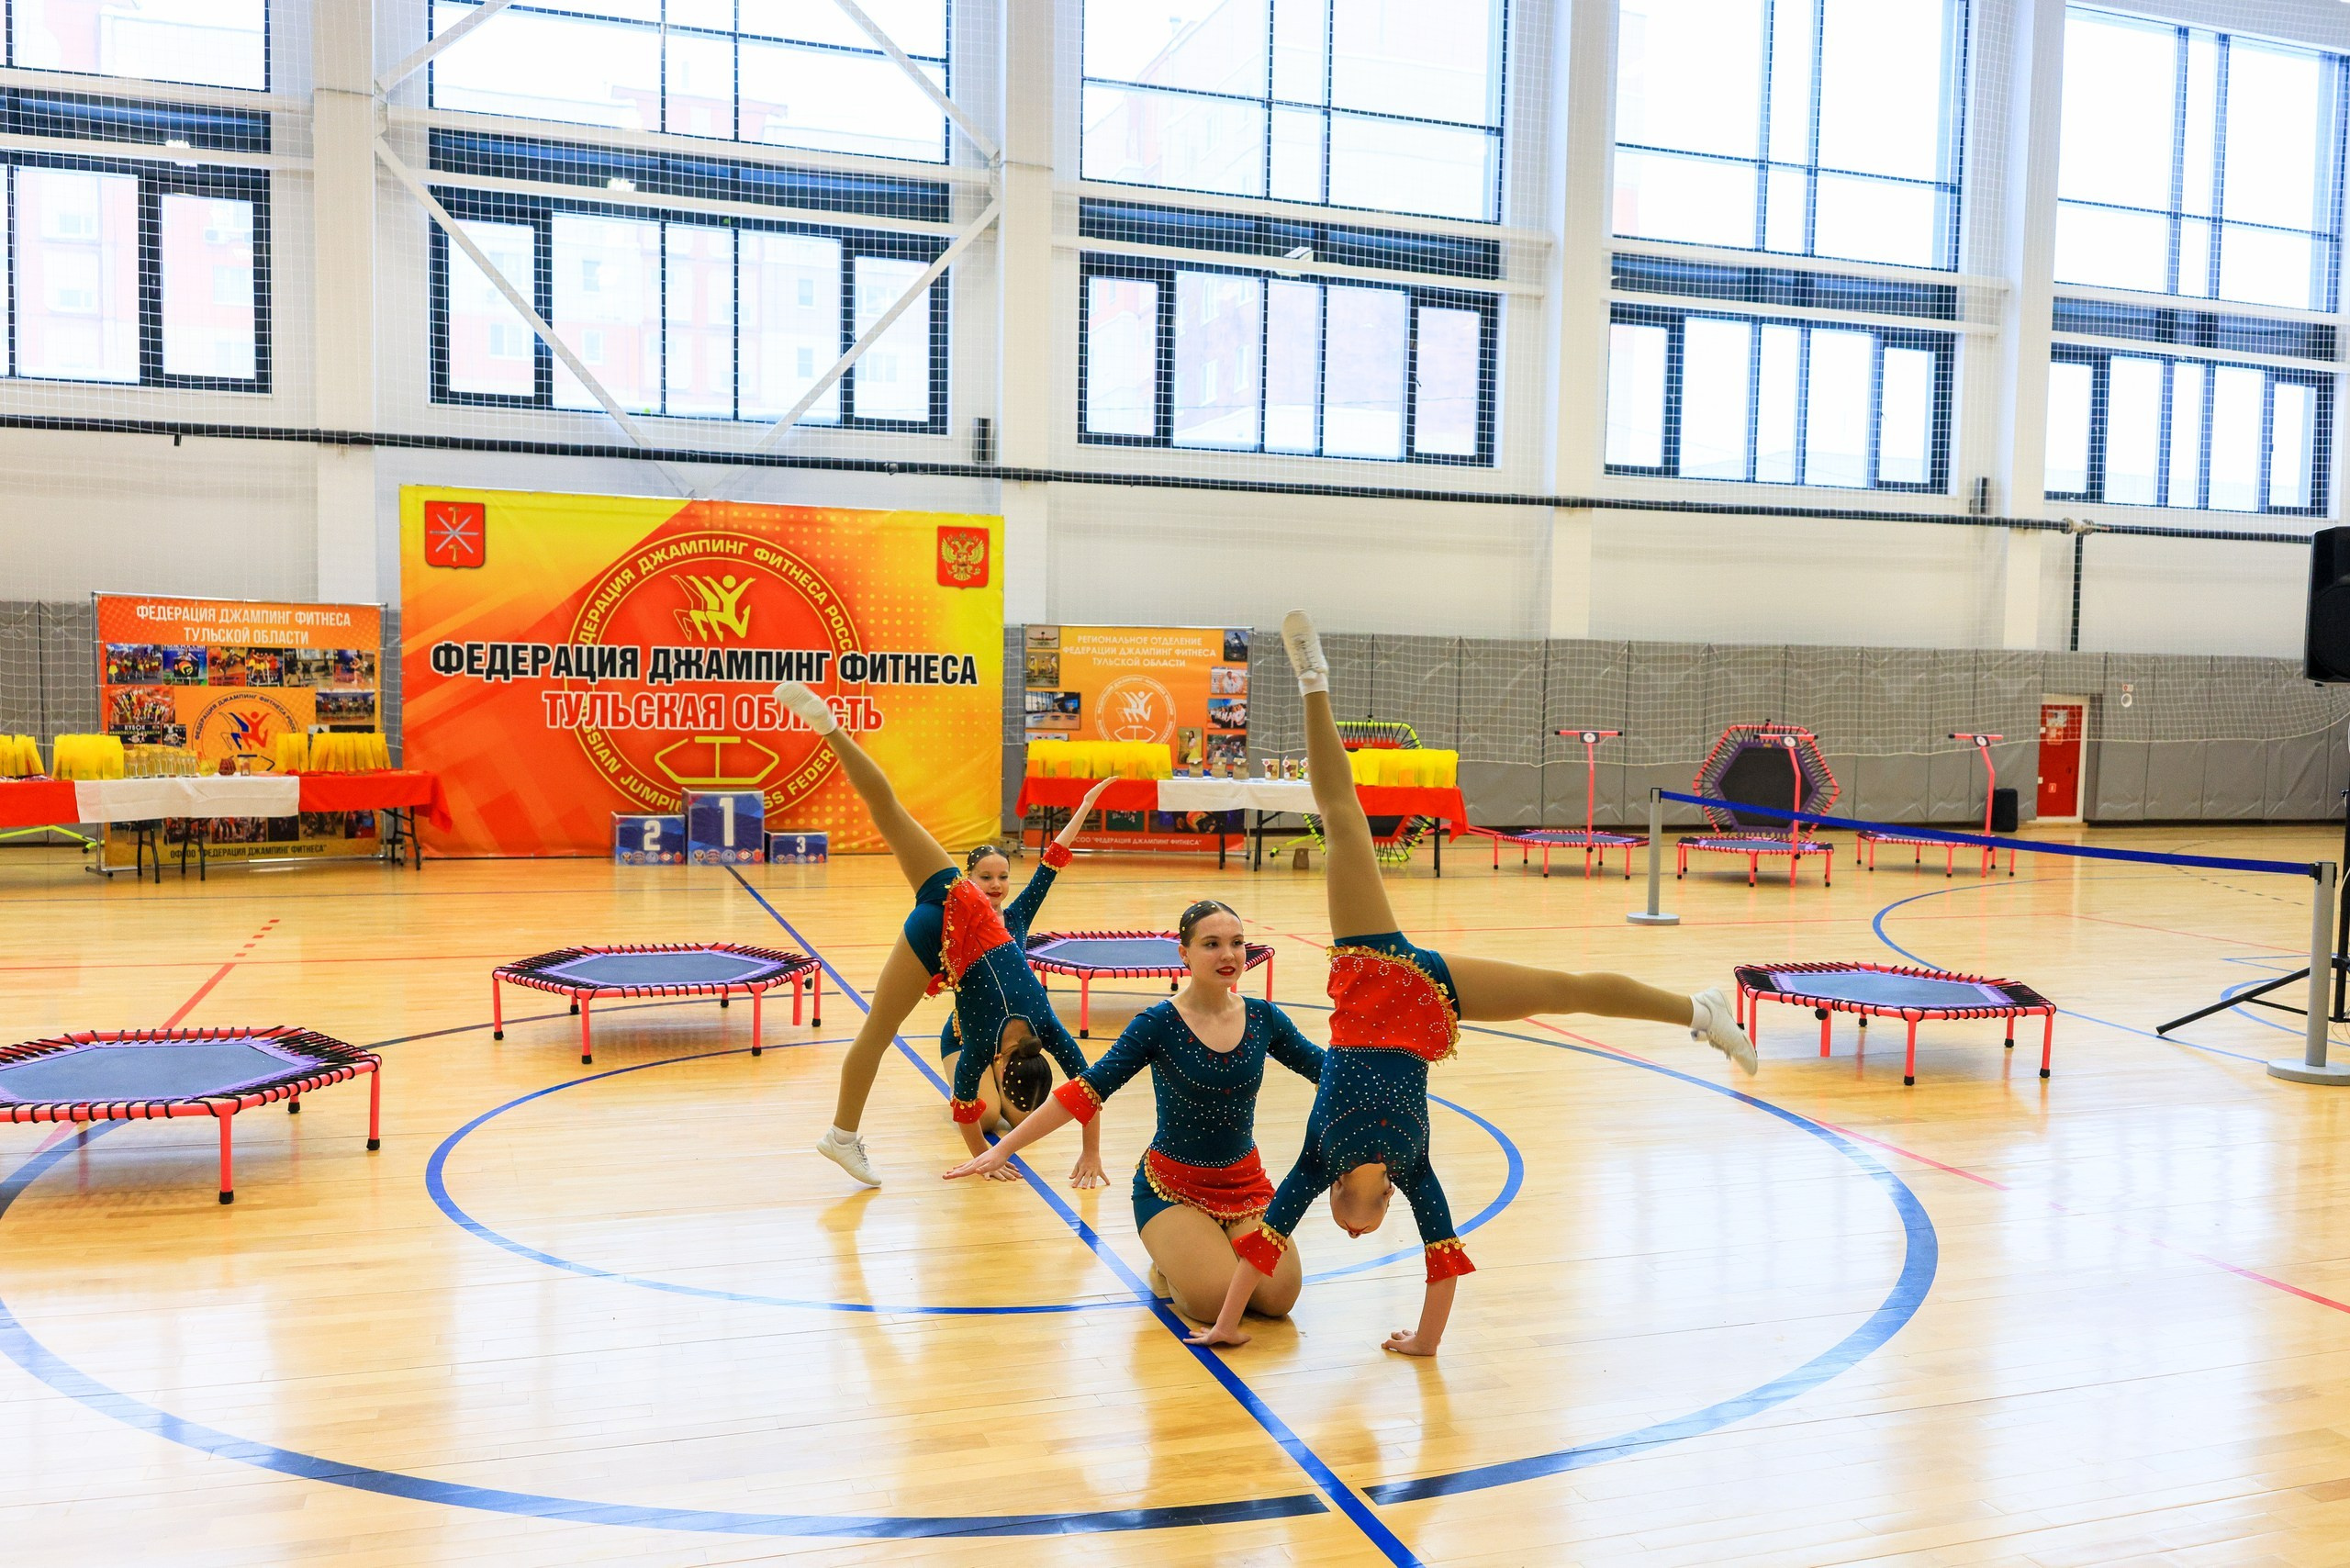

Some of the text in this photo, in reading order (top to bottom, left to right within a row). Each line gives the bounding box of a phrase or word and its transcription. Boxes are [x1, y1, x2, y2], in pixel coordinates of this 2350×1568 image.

[578, 539, 854, 652] ДЕРАЦИЯ ДЖАМПИНГ ФИТНЕСА РОСС
[136, 605, 352, 627] ФЕДЕРАЦИЯ ДЖАМПИНГ ФИТНЕСА
[184, 626, 309, 645] ТУЛЬСКОЙ ОБЛАСТИ
[1078, 635, 1203, 646] РЕГИОНАЛЬНОЕ ОТДЕЛЕНИЕ
[1062, 646, 1216, 657] ФЕДЕРАЦИИ ДЖАМПИНГ ФИТНЕСА
[1092, 656, 1186, 667] ТУЛЬСКОЙ ОБЛАСТИ
[431, 641, 979, 686] ФЕДЕРАЦИЯ ДЖАМПИНГ ФИТНЕСА
[543, 690, 884, 732] ТУЛЬСКАЯ ОБЛСТЬ
[285, 715, 297, 733] РОСС
[620, 775, 682, 812] JUMPI
[787, 748, 834, 796] FEDER
[718, 797, 734, 847] 1
[643, 820, 661, 851] 2
[796, 836, 806, 854] 3
[171, 849, 196, 858] ОФОО
[248, 846, 290, 857] ДЖАМПИНГ
